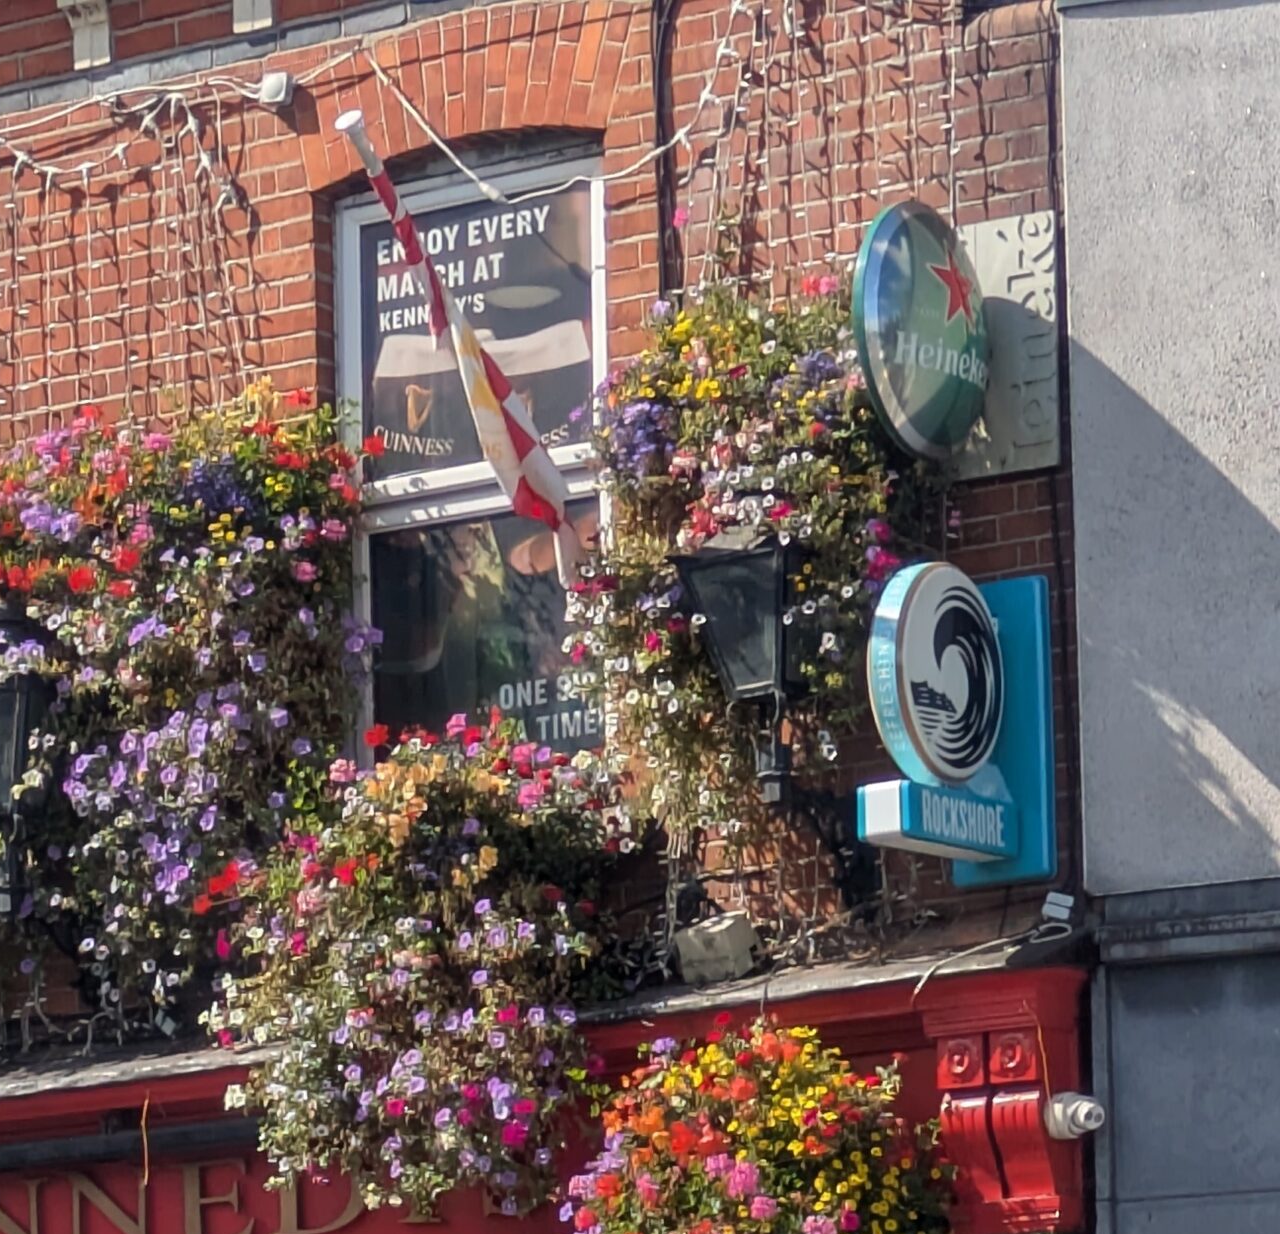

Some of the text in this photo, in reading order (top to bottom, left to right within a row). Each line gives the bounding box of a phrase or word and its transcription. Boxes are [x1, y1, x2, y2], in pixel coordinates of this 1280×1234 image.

[377, 205, 549, 265] ENOY EVERY
[377, 253, 504, 302] MACH AT
[380, 293, 484, 331] KENNY'S
[894, 331, 988, 387] Heineke
[500, 678, 547, 709] ONE
[922, 789, 1005, 847] ROCKSHORE
